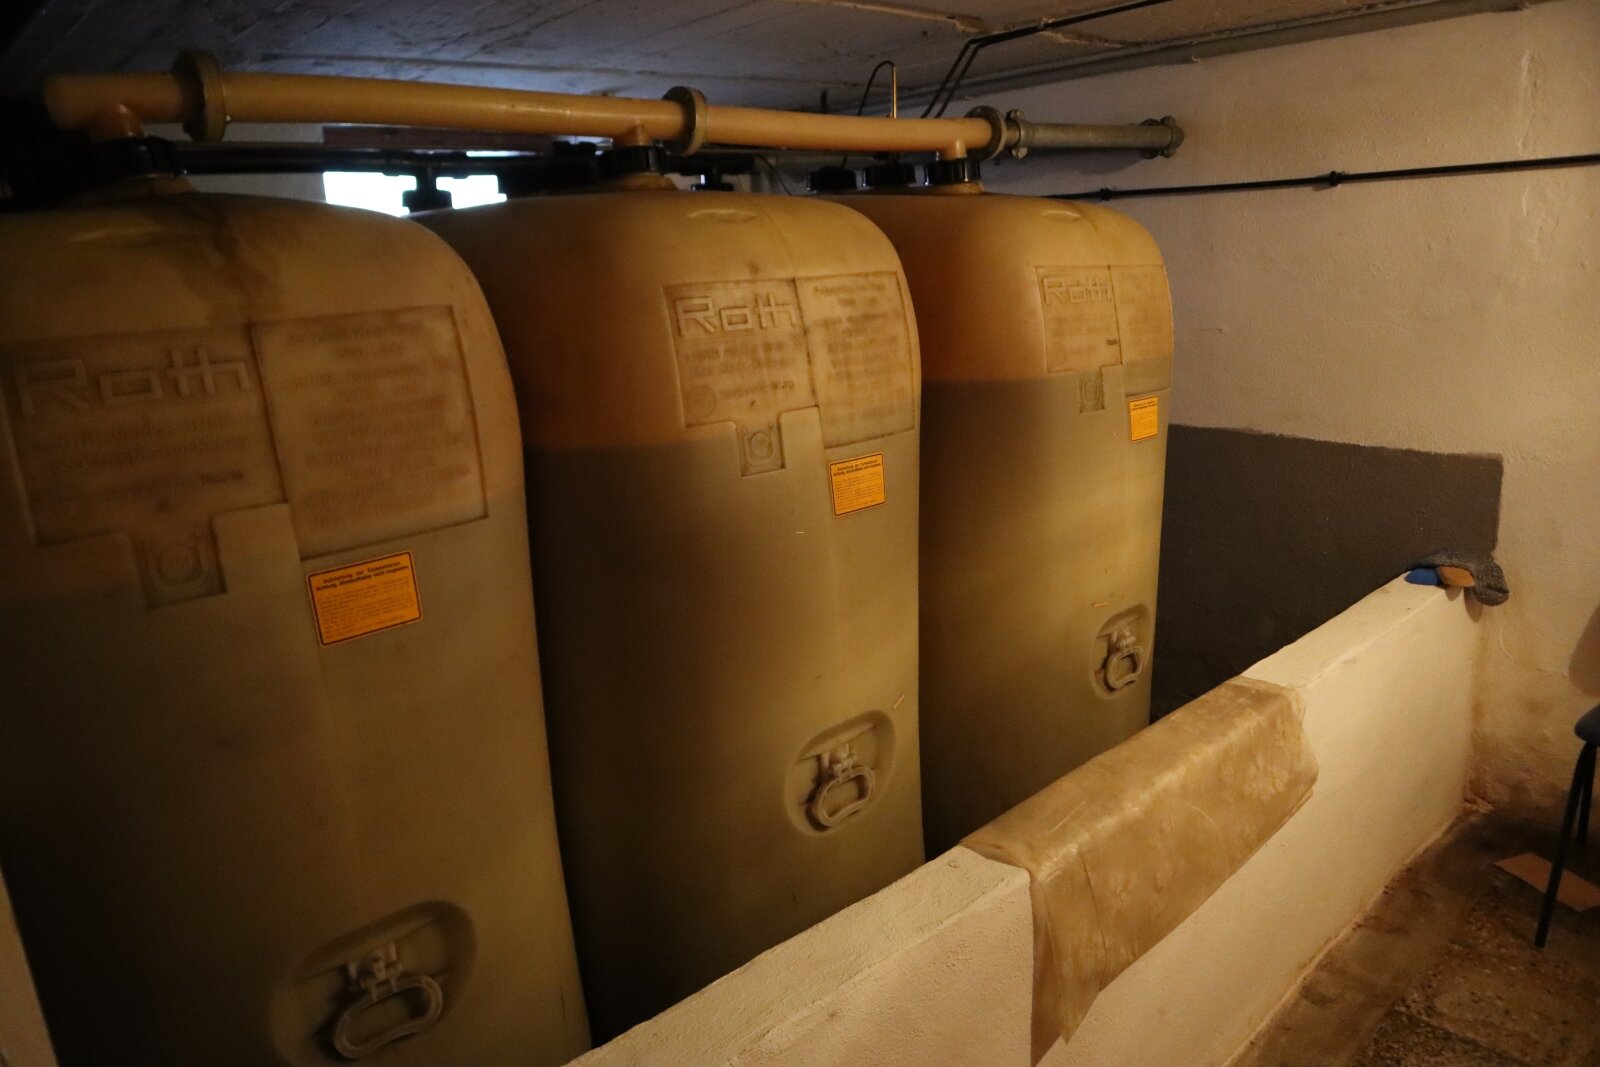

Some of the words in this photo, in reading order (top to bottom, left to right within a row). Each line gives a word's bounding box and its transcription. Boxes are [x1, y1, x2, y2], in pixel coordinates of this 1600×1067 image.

[1043, 276, 1112, 305] Roth
[676, 292, 797, 337] Roth
[14, 345, 250, 416] Roth
